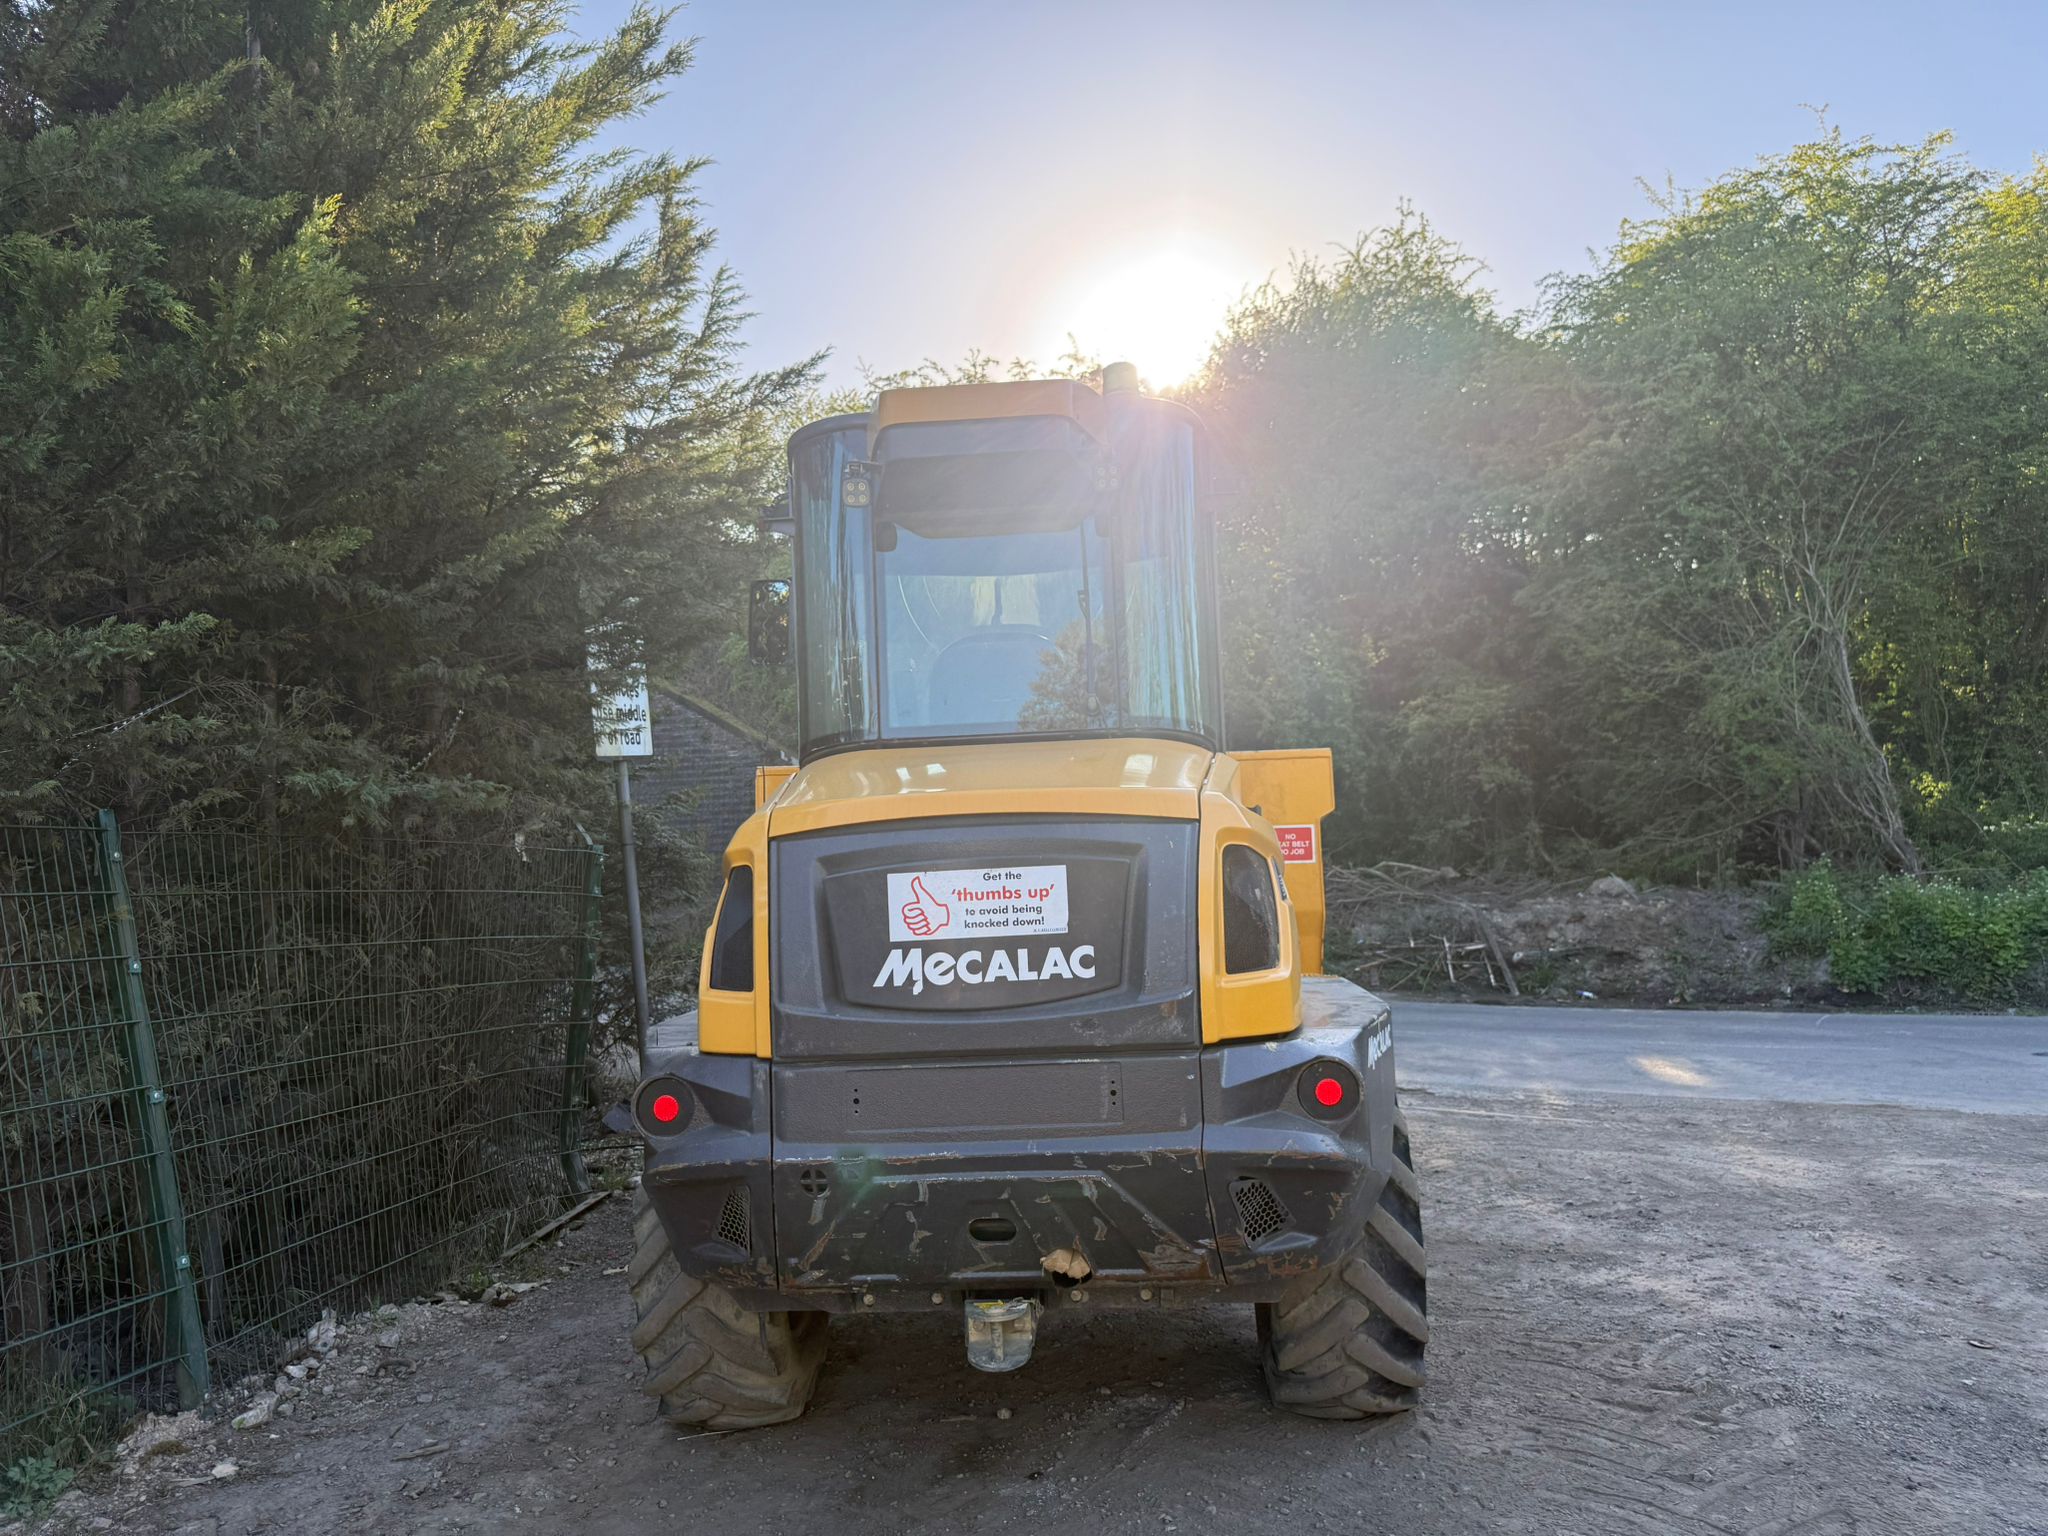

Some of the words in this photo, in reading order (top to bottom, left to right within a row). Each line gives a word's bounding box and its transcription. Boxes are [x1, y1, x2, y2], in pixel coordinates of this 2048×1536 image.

[616, 704, 647, 722] middle
[620, 729, 641, 745] road
[983, 872, 1002, 881] Get
[1004, 871, 1022, 880] the
[951, 886, 1021, 902] 'thumbs
[1027, 884, 1055, 902] up'
[965, 907, 976, 916] to
[978, 905, 1009, 915] avoid
[1012, 904, 1043, 916] being
[964, 918, 1009, 929] knocked
[1012, 917, 1045, 927] down!
